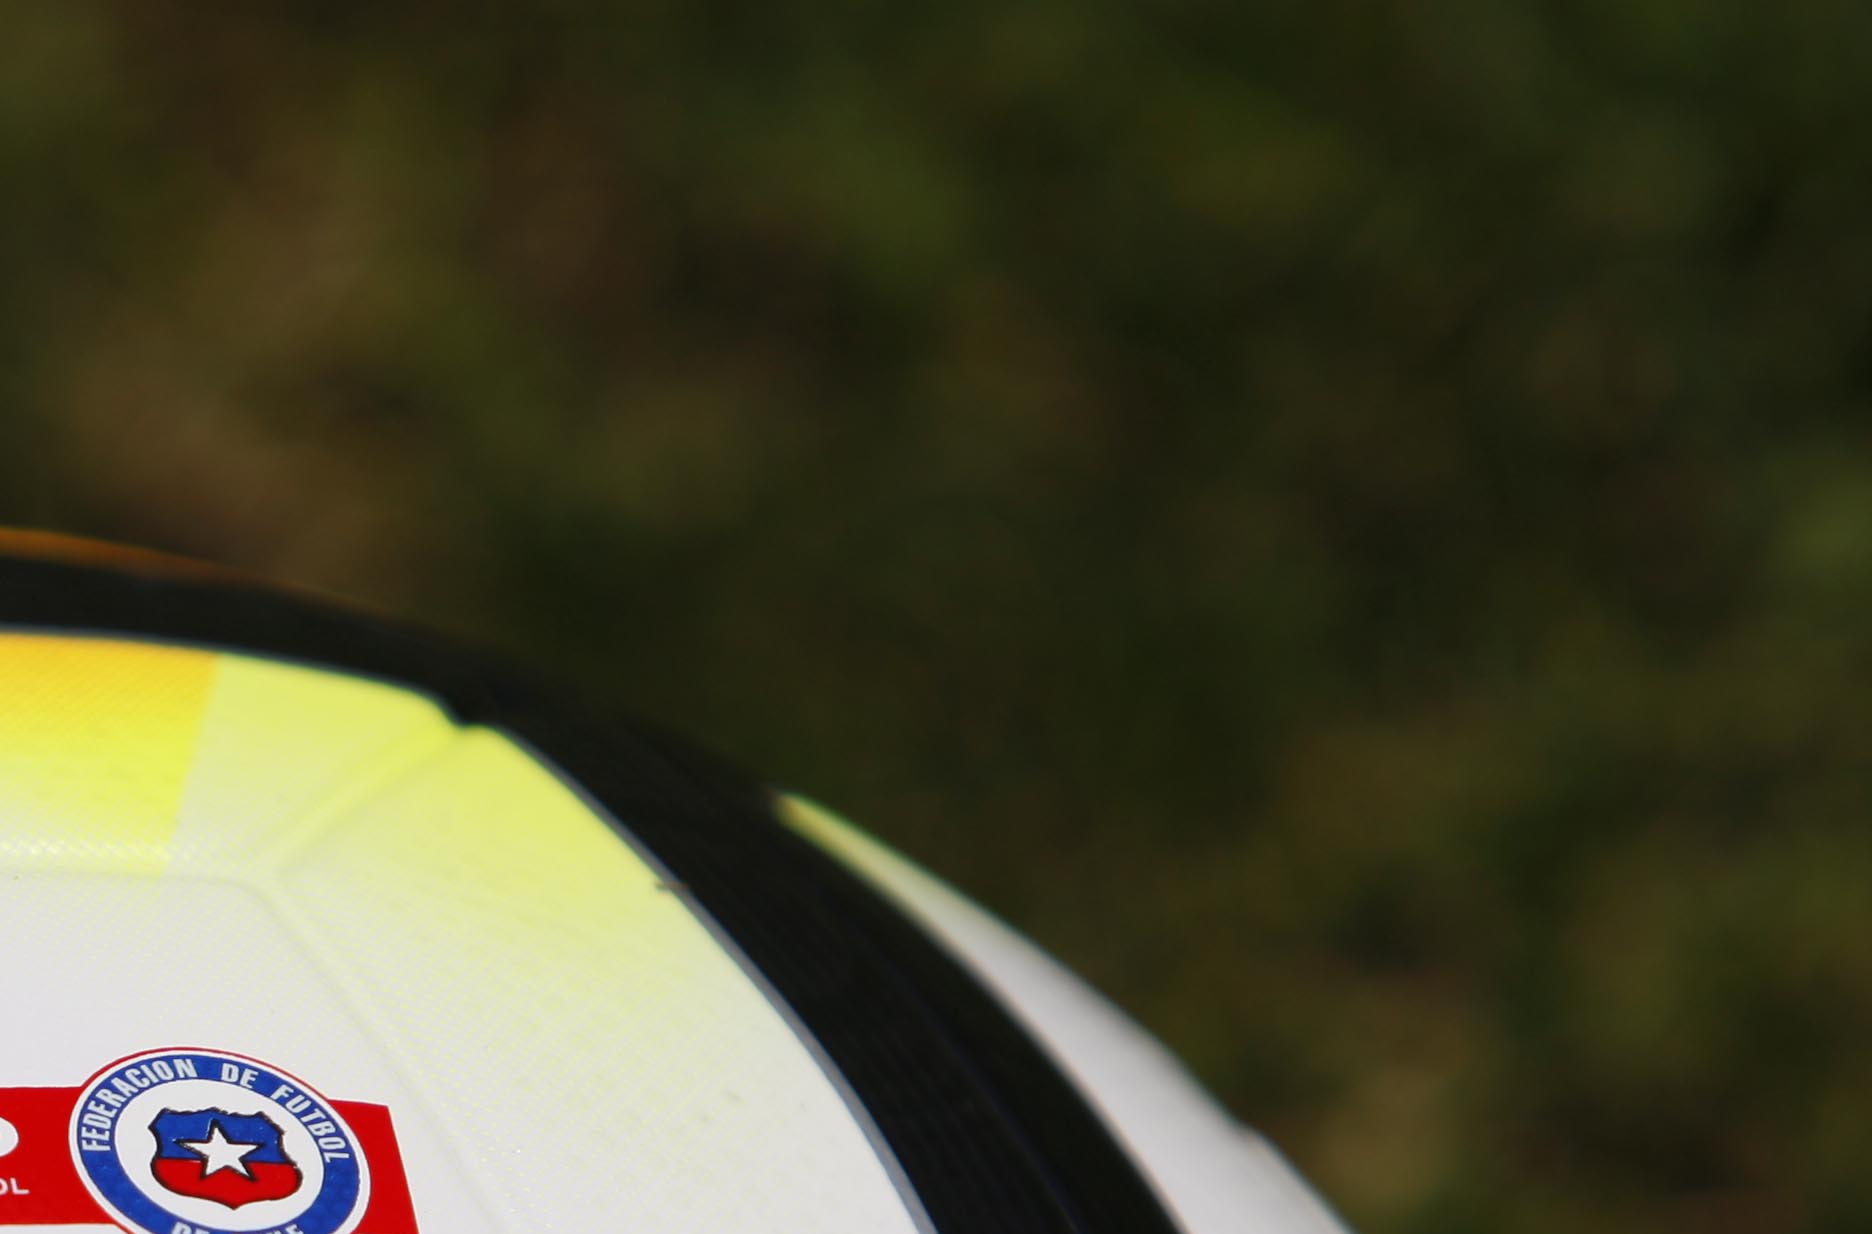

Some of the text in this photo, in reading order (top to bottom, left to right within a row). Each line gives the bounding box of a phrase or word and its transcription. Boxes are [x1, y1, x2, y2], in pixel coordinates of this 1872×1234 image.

[80, 1057, 351, 1164] FEDERACION DE FUTBOL
